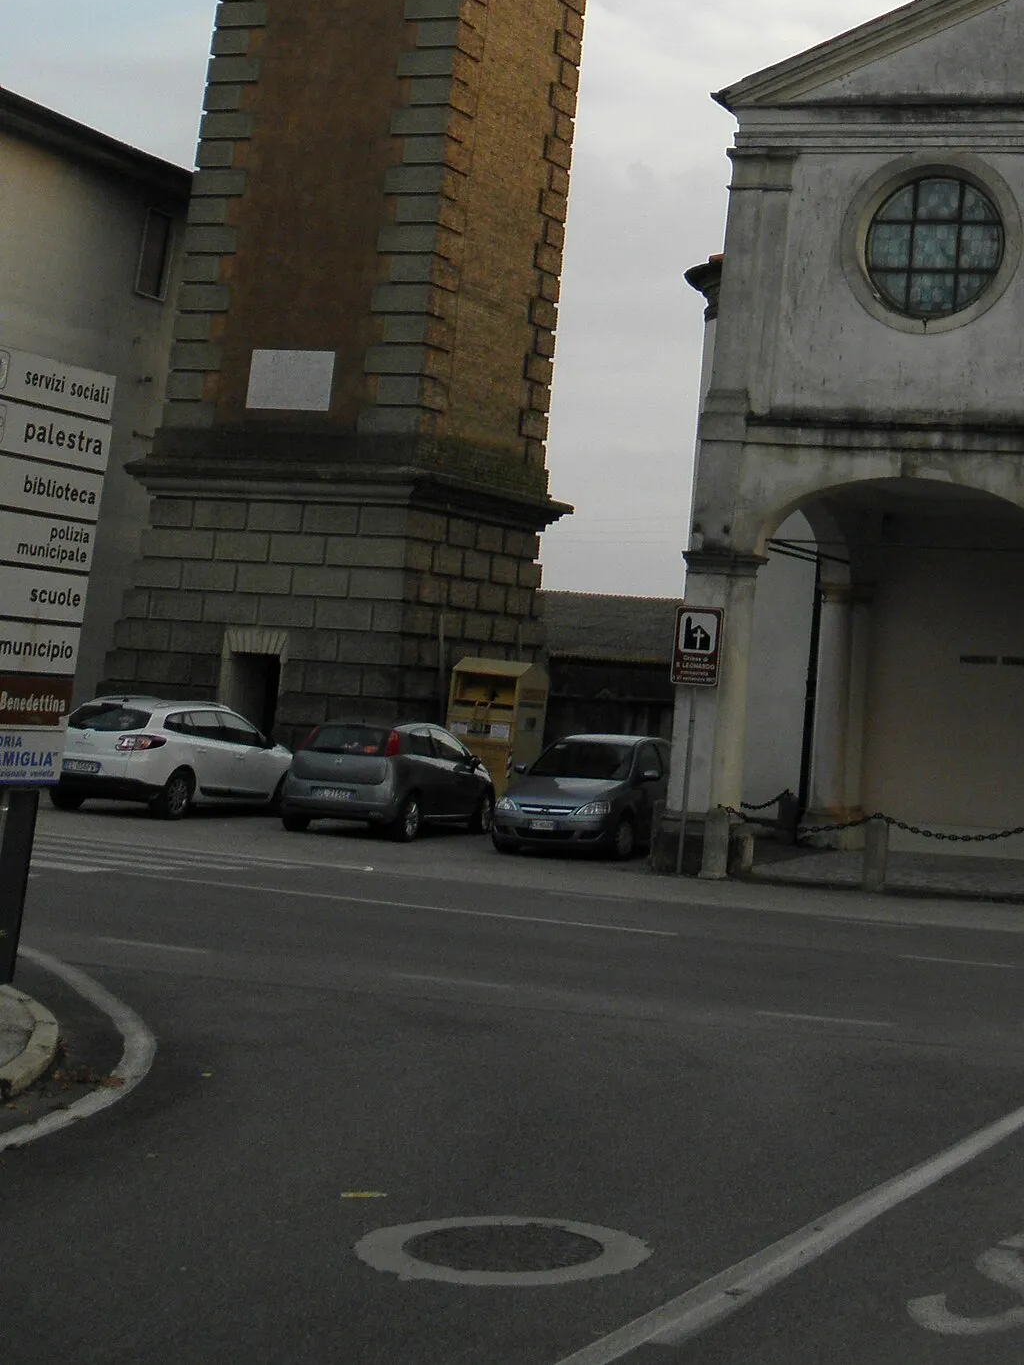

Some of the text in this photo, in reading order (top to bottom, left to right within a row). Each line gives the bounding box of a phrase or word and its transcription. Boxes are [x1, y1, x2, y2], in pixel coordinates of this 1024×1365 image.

[24, 370, 110, 405] servizi sociali
[24, 422, 102, 455] palestra
[23, 474, 96, 505] biblioteca
[49, 525, 90, 544] polizia
[17, 542, 87, 563] municipale
[30, 588, 81, 607] scuole
[0, 639, 73, 662] municipio
[0, 690, 65, 712] Benedettina
